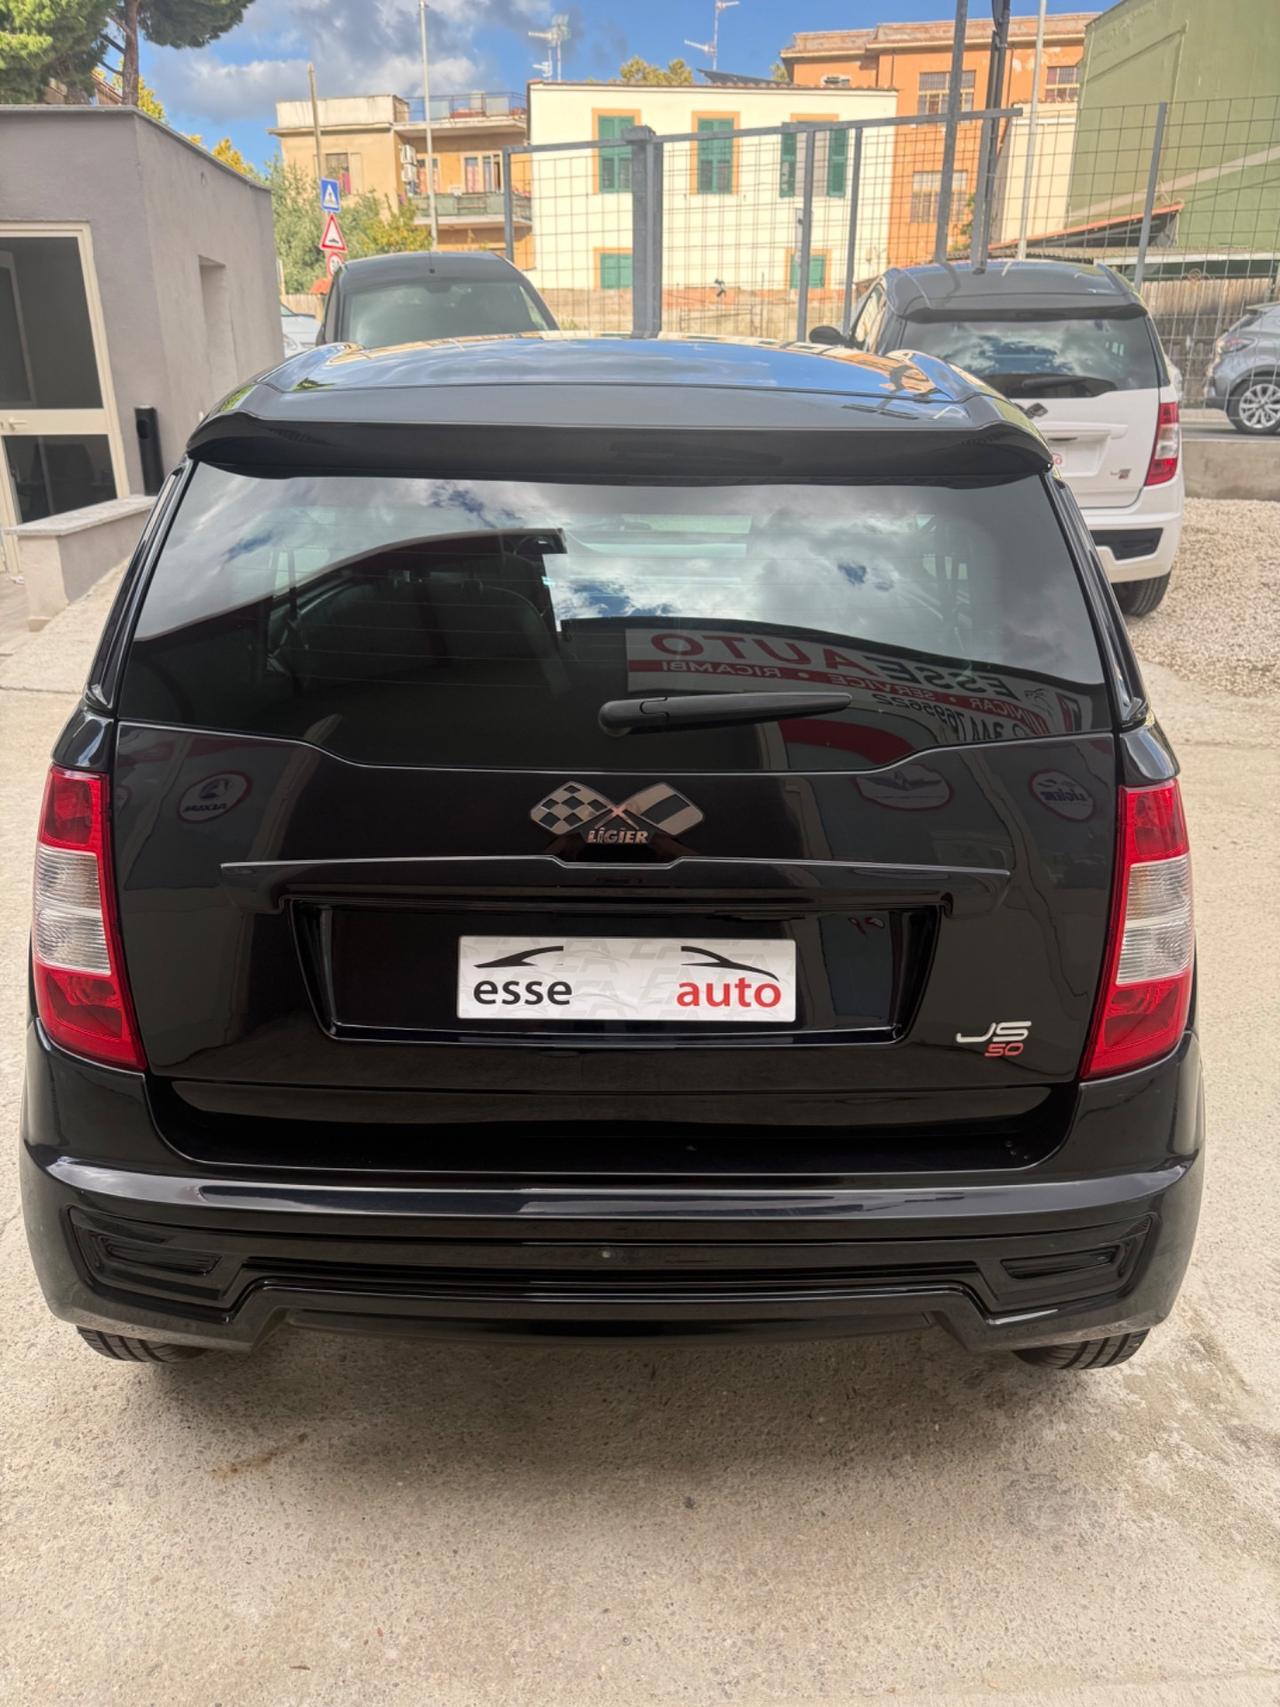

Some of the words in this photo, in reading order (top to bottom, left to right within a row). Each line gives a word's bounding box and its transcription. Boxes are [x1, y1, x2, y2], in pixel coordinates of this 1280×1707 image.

[473, 980, 573, 1005] esse
[676, 978, 782, 1007] auto
[956, 1021, 1032, 1043] JS
[984, 1042, 1024, 1057] 50
